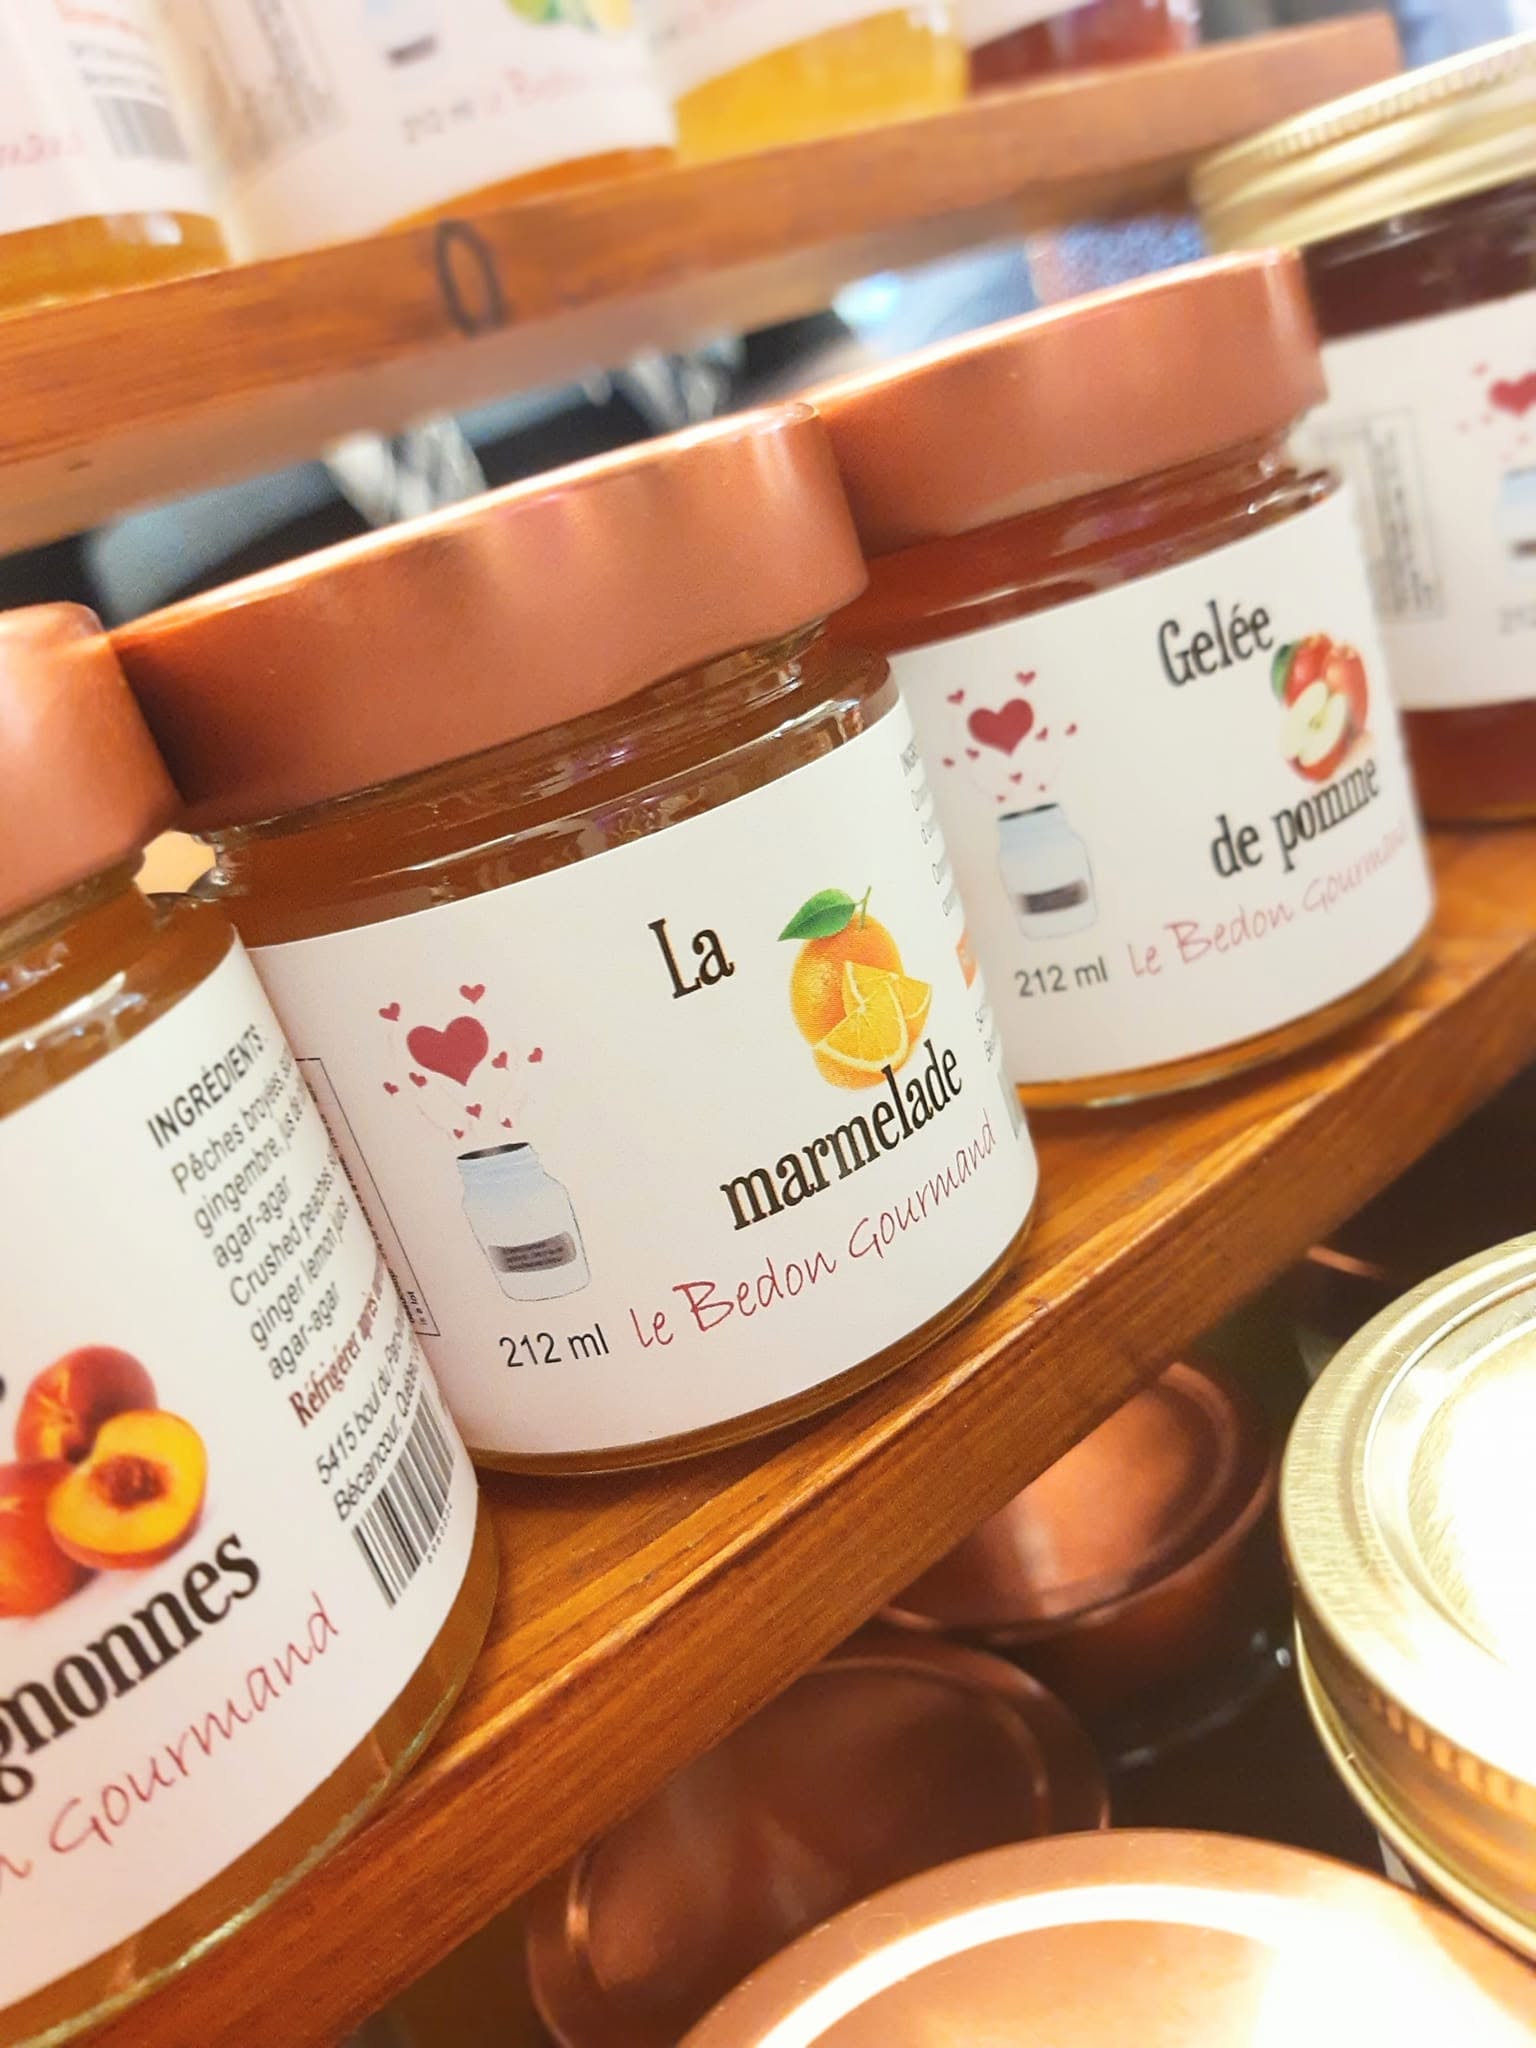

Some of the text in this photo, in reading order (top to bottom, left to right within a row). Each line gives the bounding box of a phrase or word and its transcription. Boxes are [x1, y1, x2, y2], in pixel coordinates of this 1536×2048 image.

[1158, 599, 1276, 688] Gelée
[1210, 758, 1380, 878] de pomme
[648, 917, 735, 999] La
[1015, 955, 1109, 998] 212 ml
[1164, 903, 1295, 967] Bedon
[171, 1121, 245, 1196] Pêches
[719, 1038, 962, 1231] marmelade
[213, 1174, 292, 1268] agar-agar
[229, 1216, 302, 1306] Crushed
[673, 1250, 837, 1332] Bedon
[848, 1107, 998, 1259] Gourmand
[250, 1273, 305, 1351] ginger
[268, 1280, 340, 1380] agar-agar
[499, 1323, 609, 1368] 212 ml
[288, 1329, 361, 1428] Réfrigérer
[315, 1427, 359, 1486] 5415
[48, 1590, 340, 1856] Gourmand
